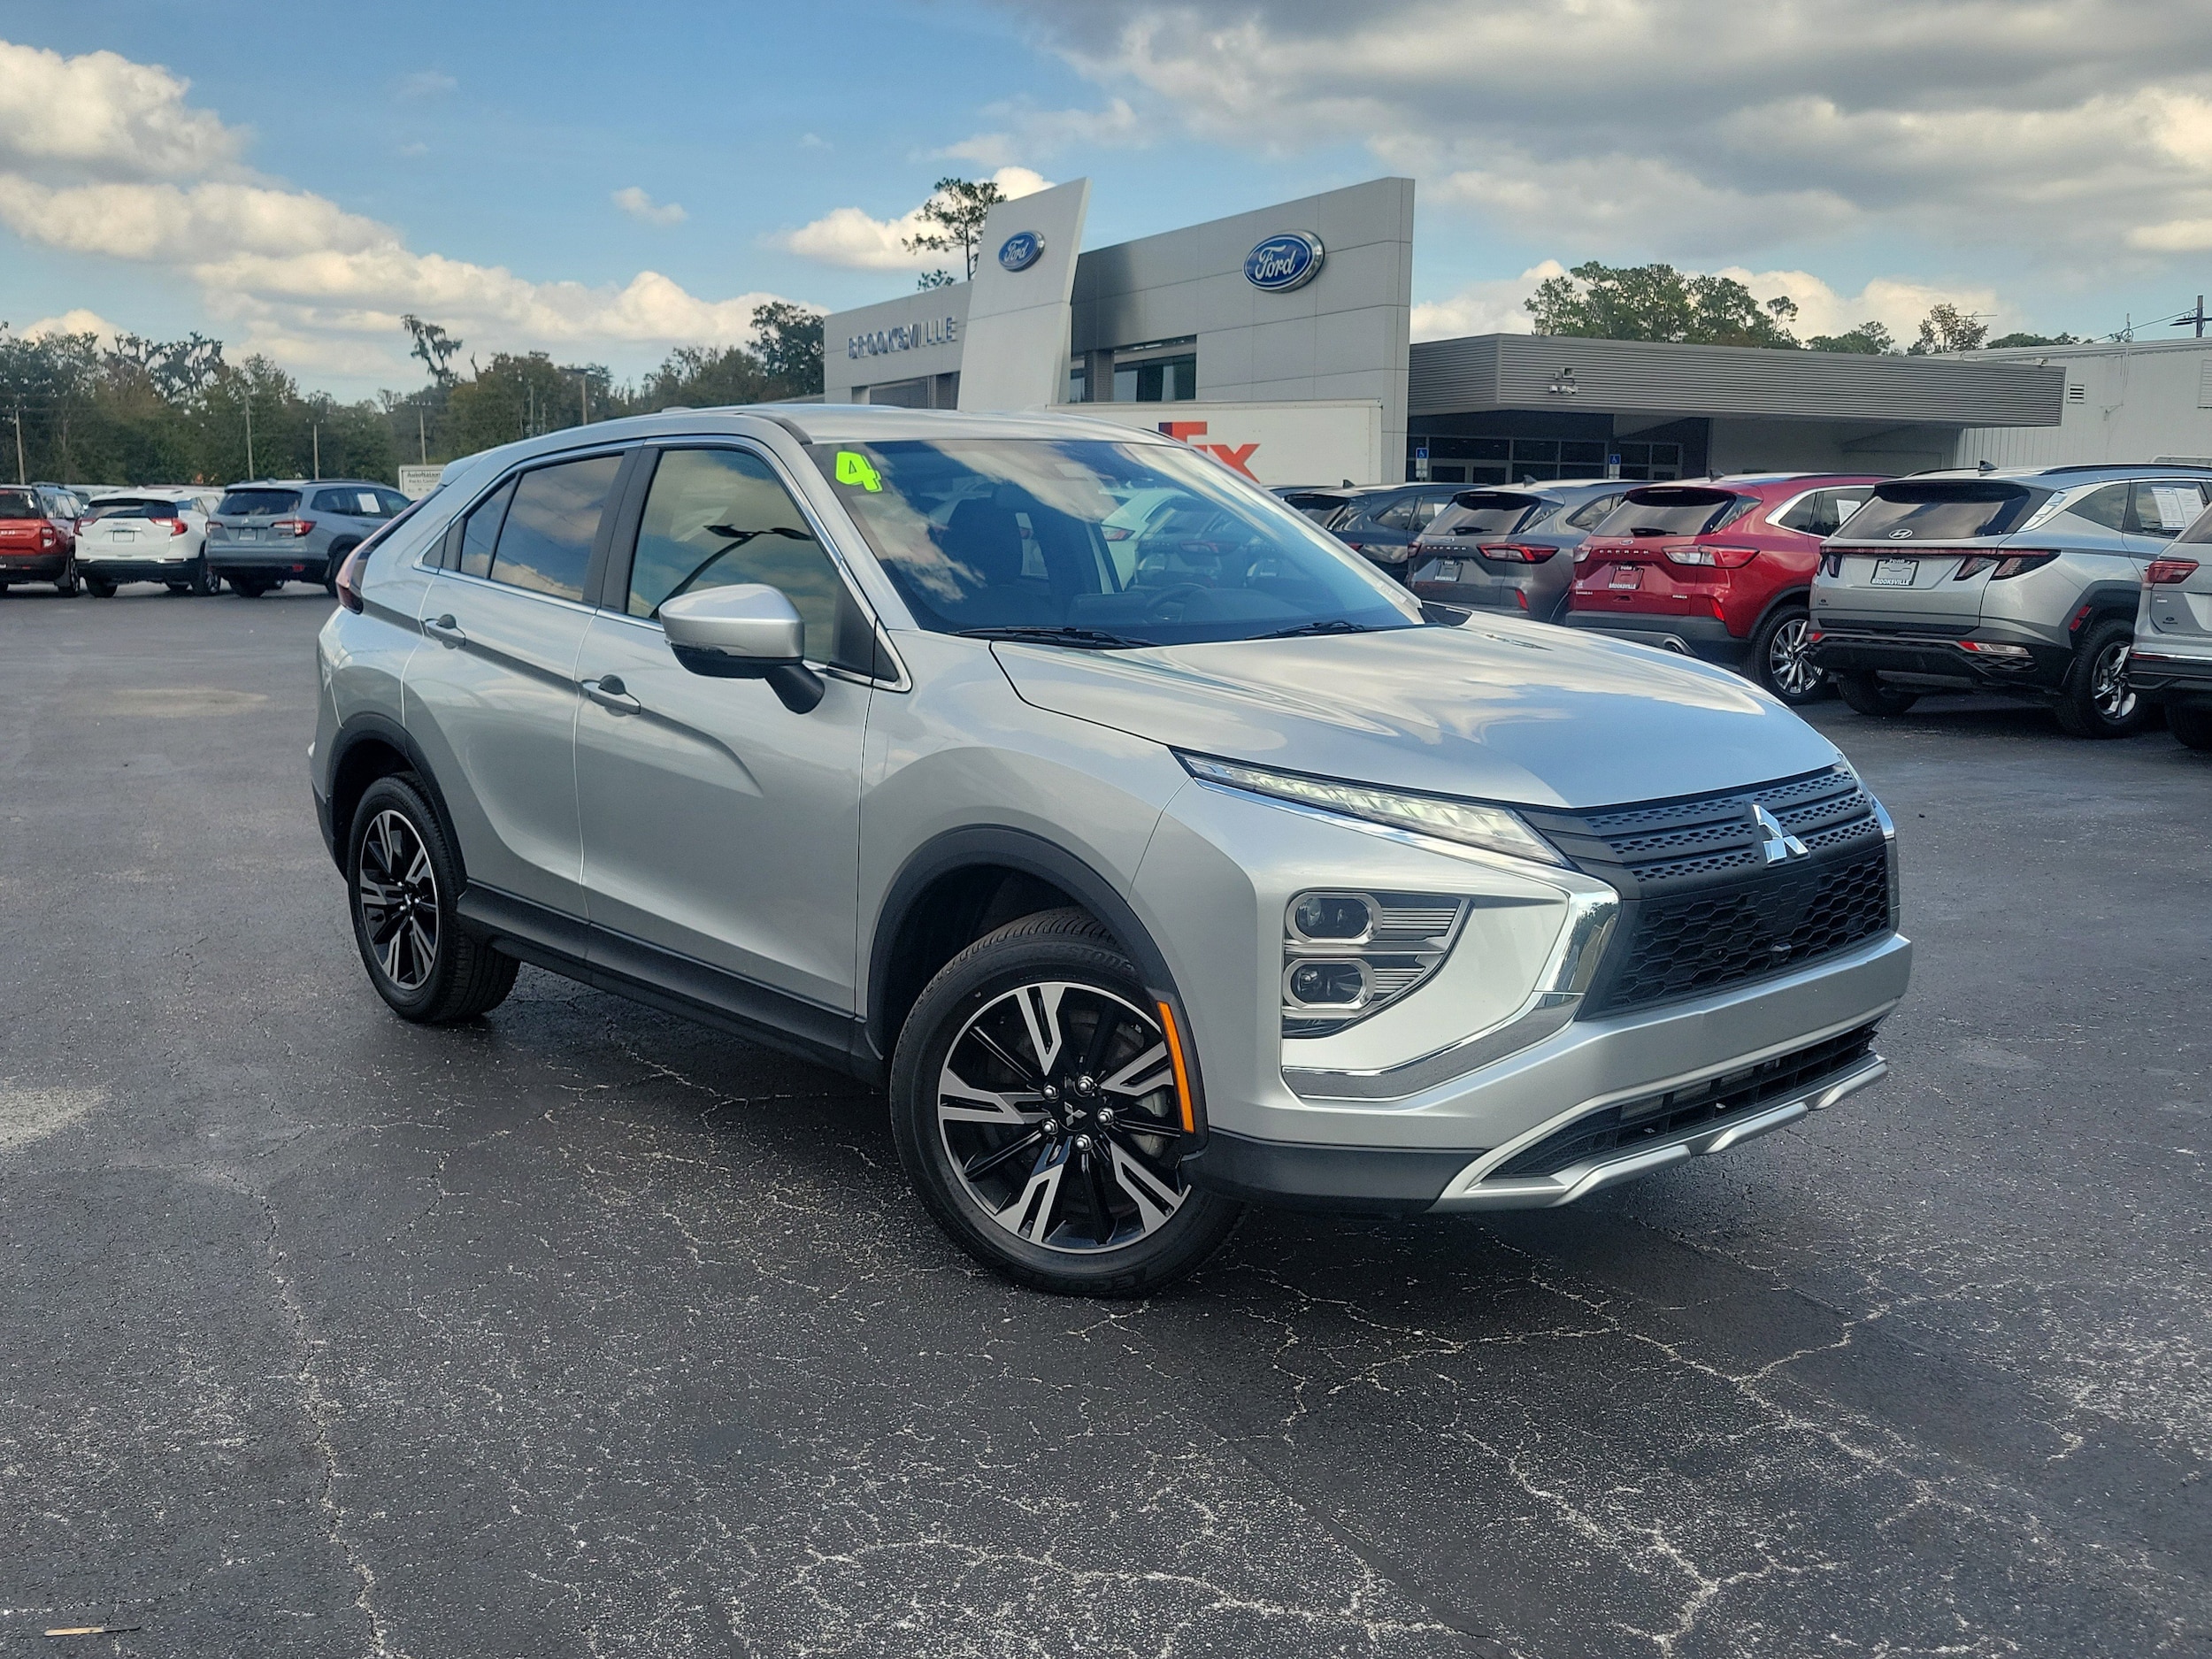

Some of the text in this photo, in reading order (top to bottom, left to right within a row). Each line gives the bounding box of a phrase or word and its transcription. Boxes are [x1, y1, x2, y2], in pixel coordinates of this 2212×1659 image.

[1003, 238, 1030, 263] Ford
[1255, 244, 1297, 280] Ford
[848, 317, 955, 358] BROOKSVILLE
[835, 450, 883, 493] 4
